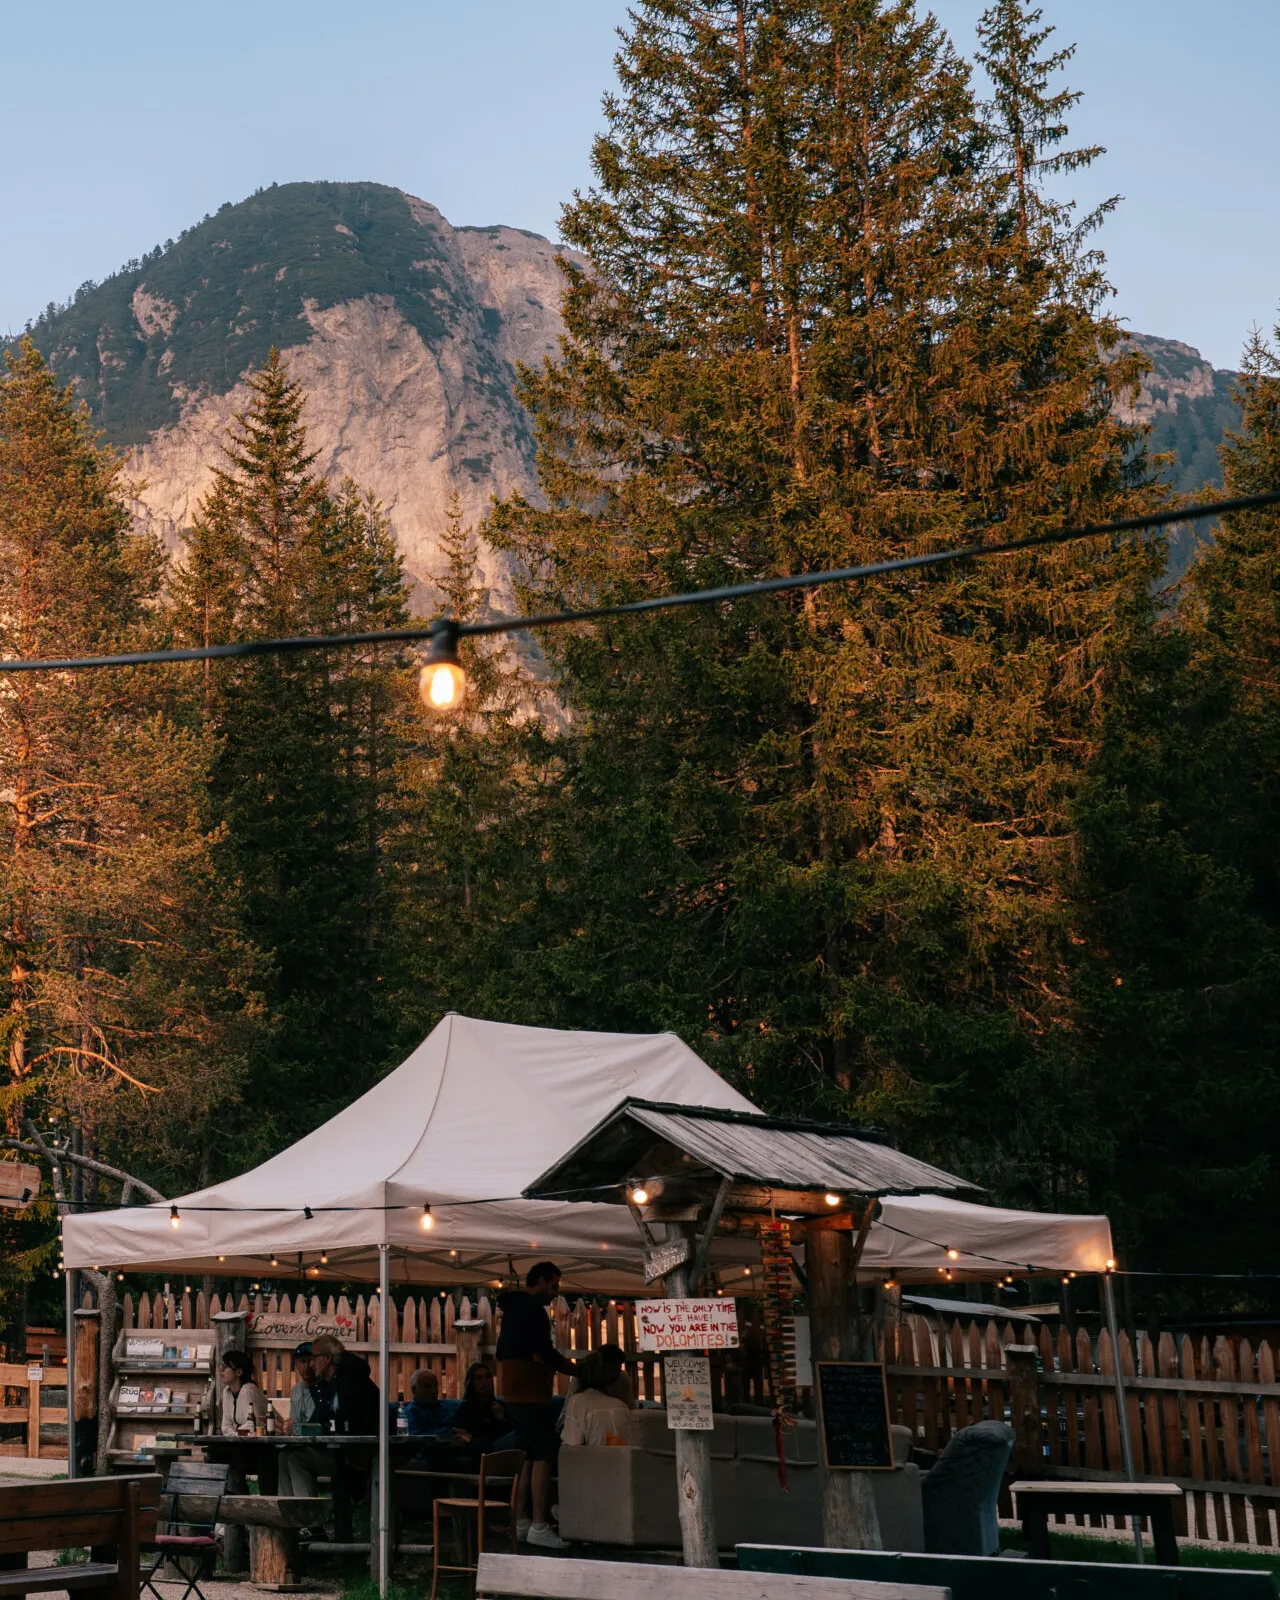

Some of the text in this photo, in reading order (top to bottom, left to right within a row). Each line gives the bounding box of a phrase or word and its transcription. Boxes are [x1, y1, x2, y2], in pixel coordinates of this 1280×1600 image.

[641, 1305, 661, 1313] NOW
[675, 1304, 690, 1313] THE
[693, 1303, 714, 1313] ONLY
[668, 1314, 682, 1322] WE
[305, 1315, 355, 1337] Corner
[643, 1322, 738, 1335] NOW YOU ARE IN THE
[666, 1359, 707, 1368] WELCOME
[839, 1452, 877, 1465] EYES
